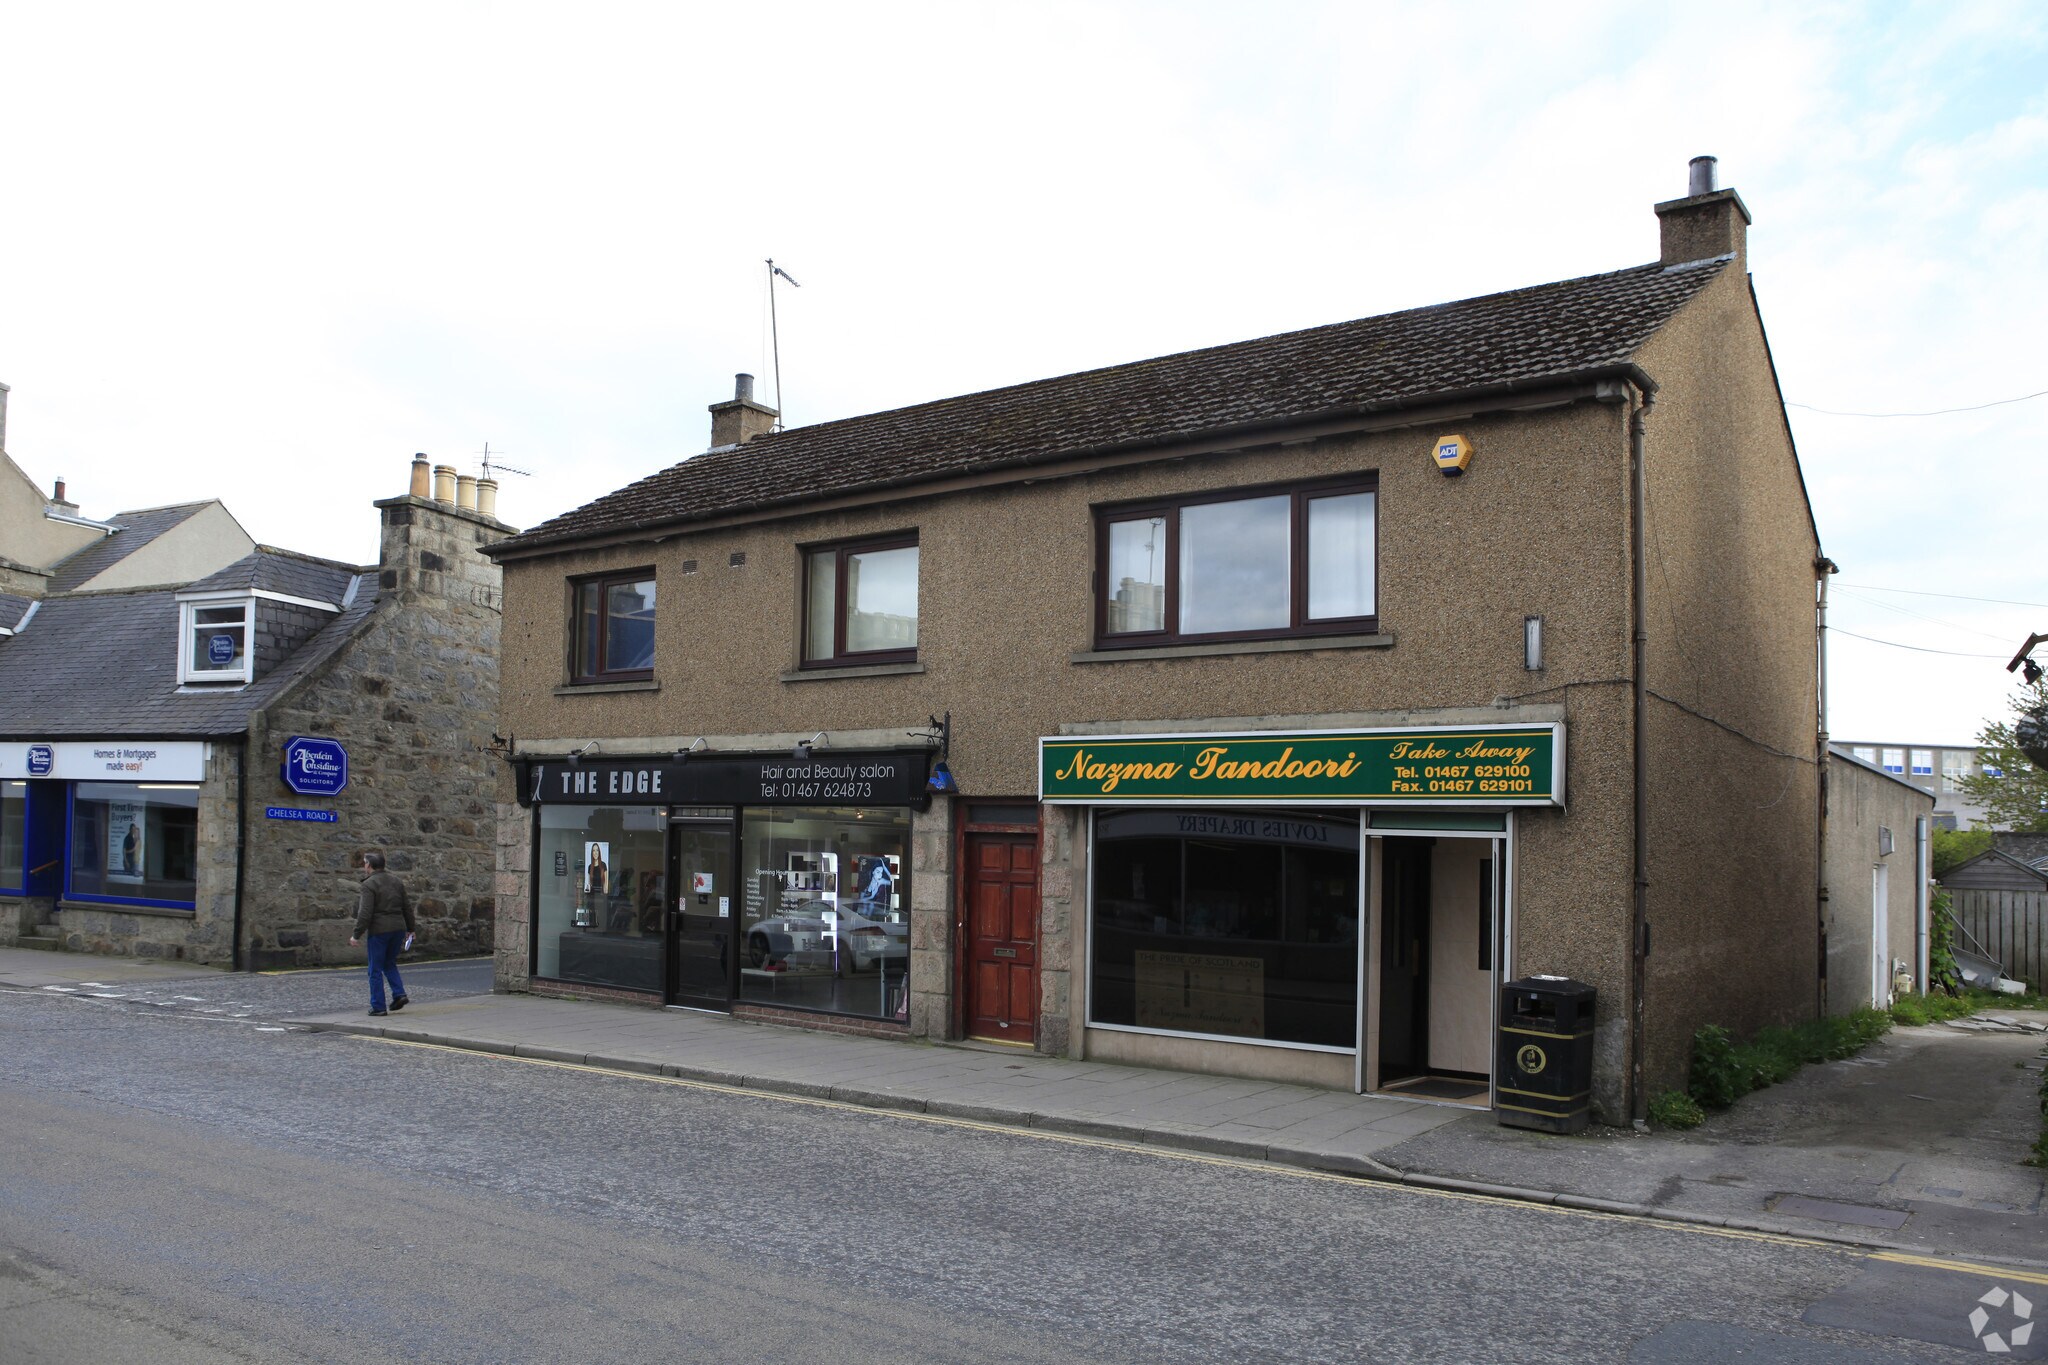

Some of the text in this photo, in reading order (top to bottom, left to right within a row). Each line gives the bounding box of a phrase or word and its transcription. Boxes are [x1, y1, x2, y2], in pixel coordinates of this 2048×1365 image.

[1440, 446, 1458, 457] ADT
[94, 749, 157, 760] Homes & Mortgages
[1389, 739, 1536, 765] Take Away
[106, 761, 143, 773] made easy!
[301, 758, 341, 773] Considine
[760, 763, 895, 781] Hair and Beauty salon
[1055, 747, 1362, 793] Nazma Tandoori
[1394, 764, 1531, 778] Tel. 01467 629100
[561, 770, 662, 794] THE EDGE
[1391, 779, 1533, 792] Fax. 01467 629101
[761, 782, 872, 798] Tel: 01467 624873
[111, 812, 136, 823] Buyers?
[268, 808, 327, 820] CHELSEA ROAD
[755, 868, 776, 877] Opening
[1139, 952, 1261, 970] THE PRIDE OF SCOTLAND
